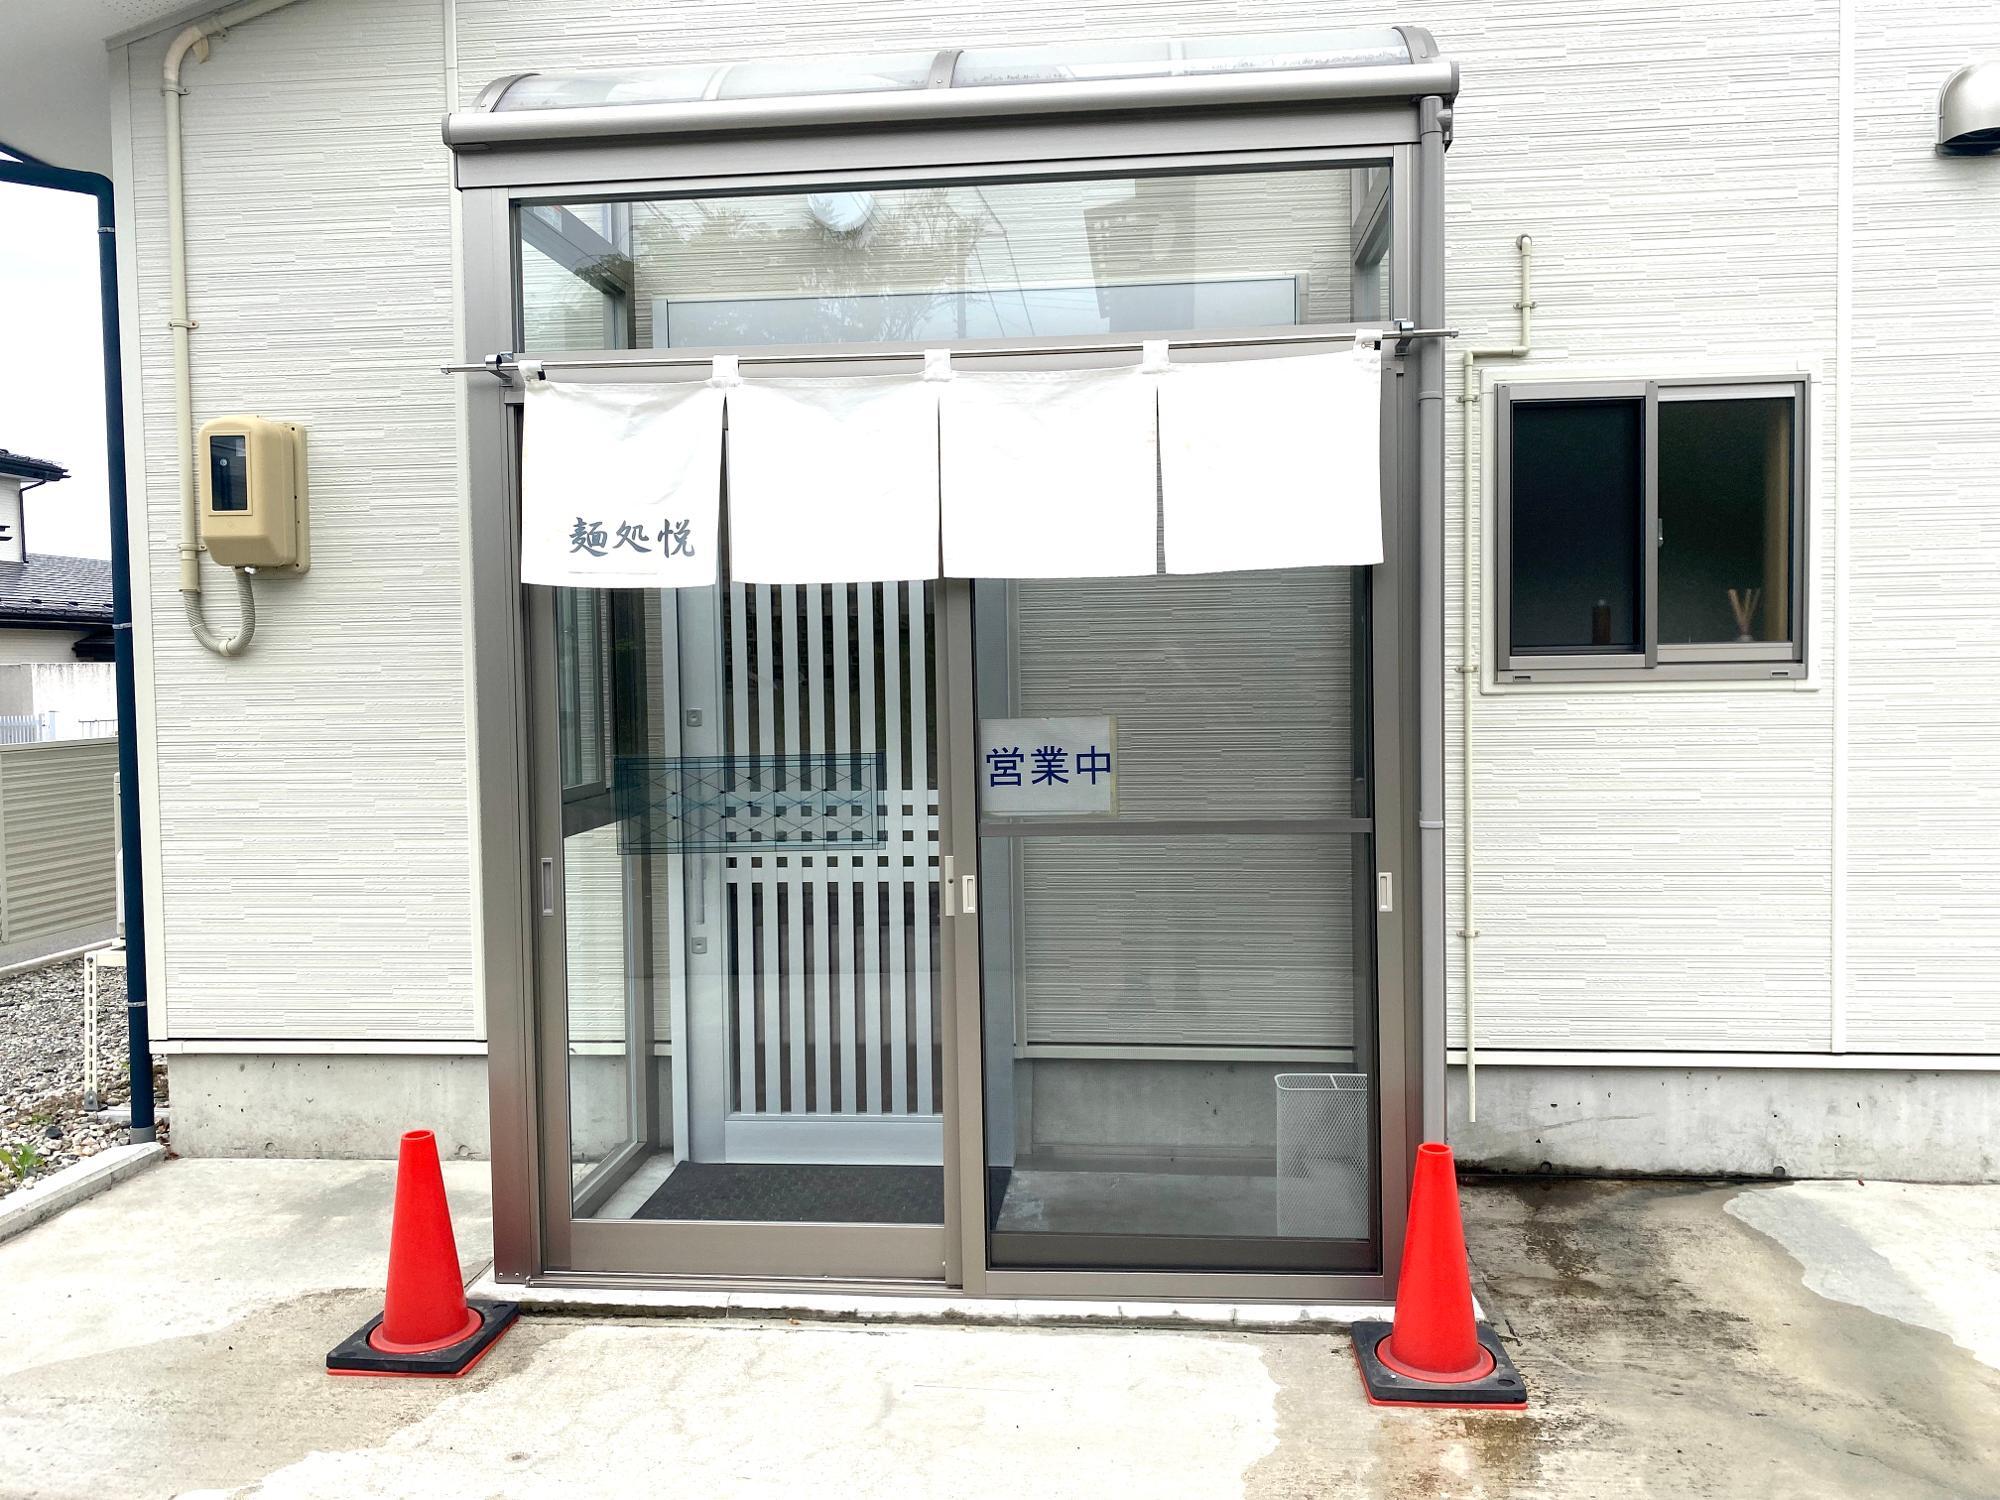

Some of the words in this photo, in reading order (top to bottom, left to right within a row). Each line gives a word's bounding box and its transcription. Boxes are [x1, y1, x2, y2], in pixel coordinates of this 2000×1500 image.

[569, 517, 695, 558] 麺処悦
[986, 745, 1111, 787] 営業中
